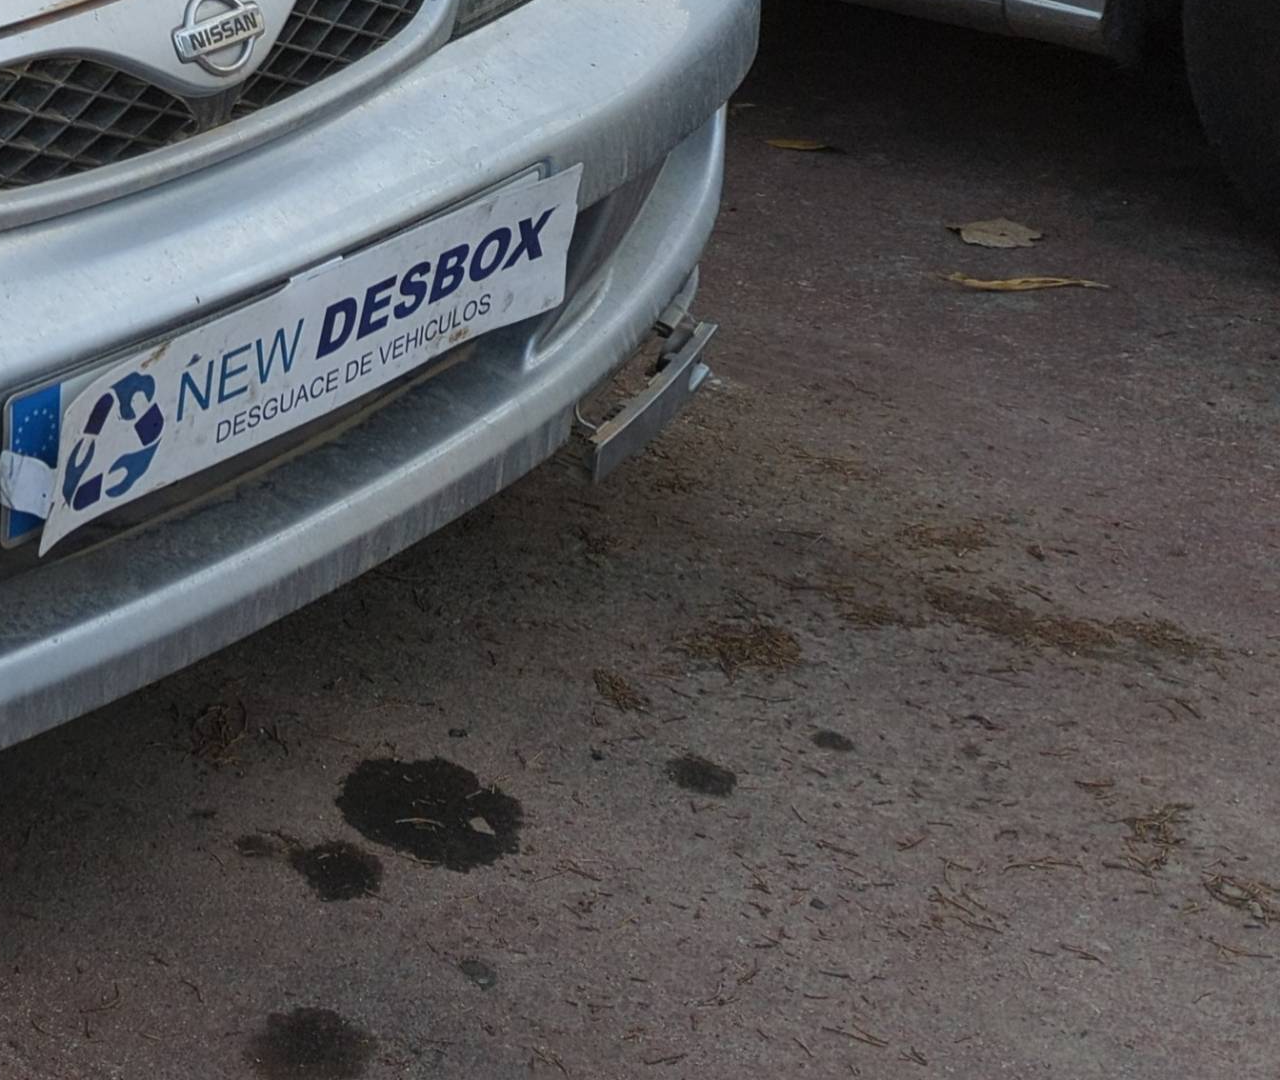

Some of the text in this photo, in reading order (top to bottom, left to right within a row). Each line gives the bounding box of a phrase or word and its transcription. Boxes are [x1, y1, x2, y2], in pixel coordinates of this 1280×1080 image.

[190, 12, 258, 51] NISSAN
[176, 206, 557, 422] NEW DESBOX
[216, 293, 491, 443] DESGUACE DE VEHICULOS
